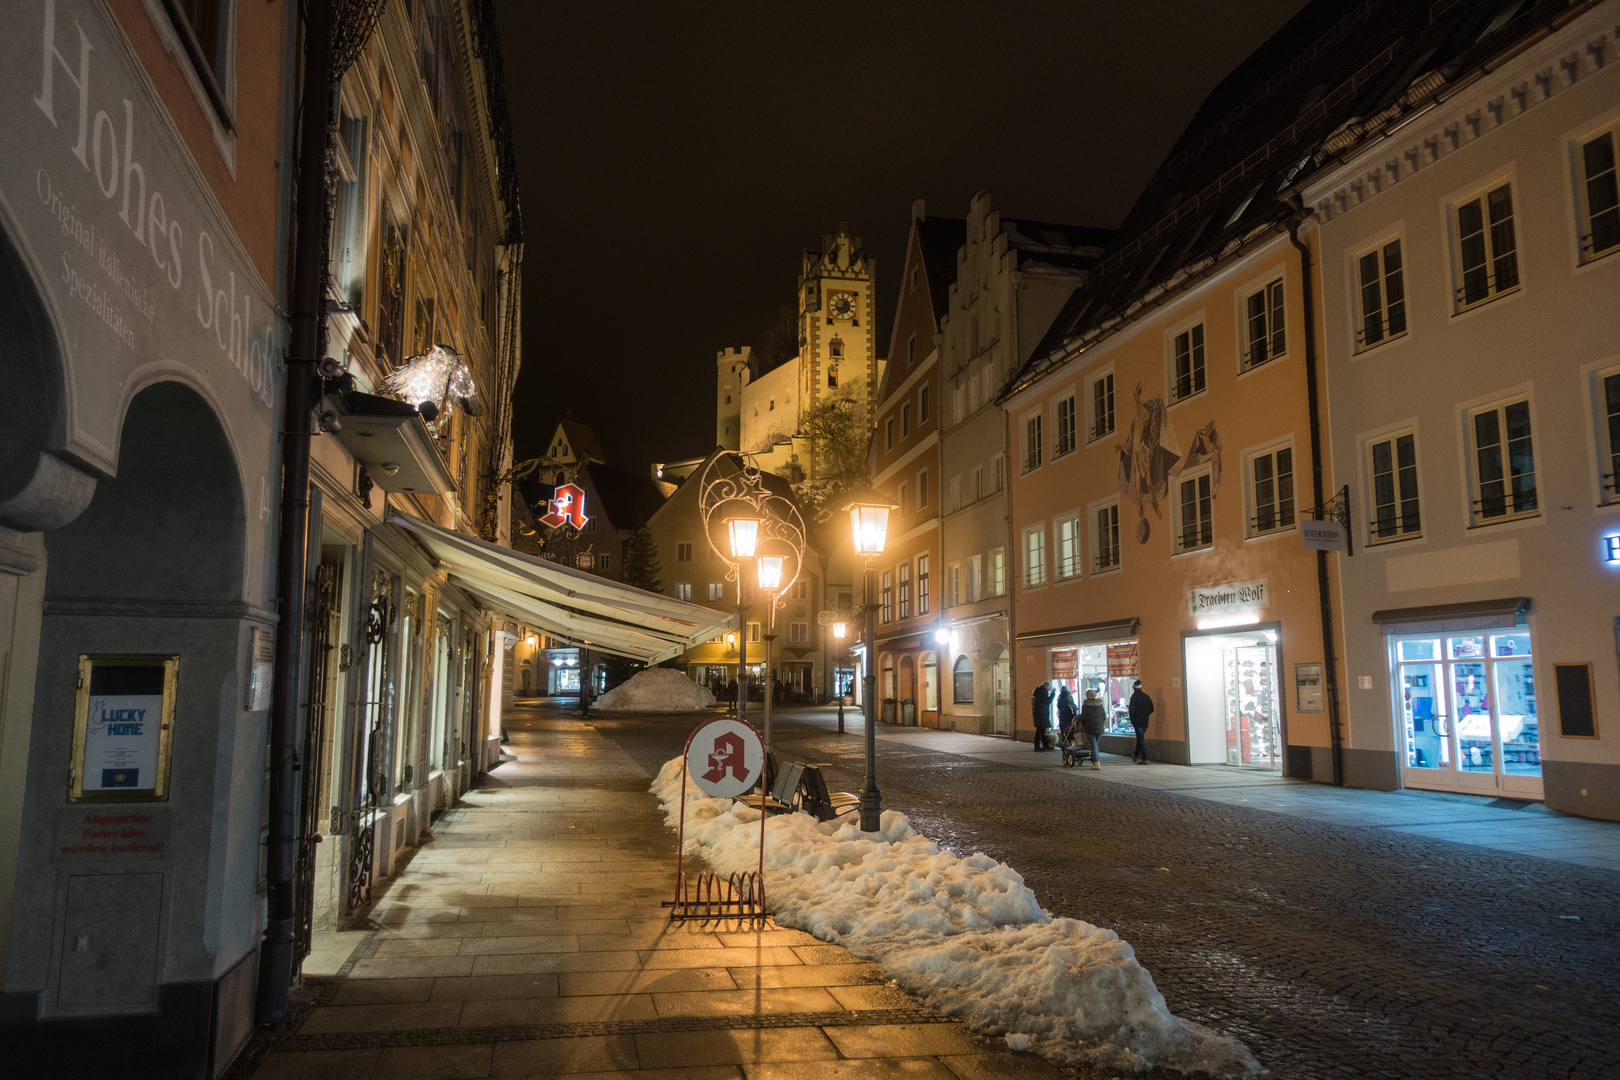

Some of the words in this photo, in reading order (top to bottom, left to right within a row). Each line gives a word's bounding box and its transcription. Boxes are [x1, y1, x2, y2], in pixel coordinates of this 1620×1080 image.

[34, 0, 183, 290] Hohes
[197, 230, 275, 409] Schloß
[37, 168, 95, 257] Original
[98, 238, 155, 324] italienische
[61, 251, 135, 350] Spezialitäten
[1198, 591, 1237, 609] Trachten
[1238, 584, 1264, 603] Wolf
[101, 708, 146, 722] LUCKY
[107, 723, 143, 735] HOME
